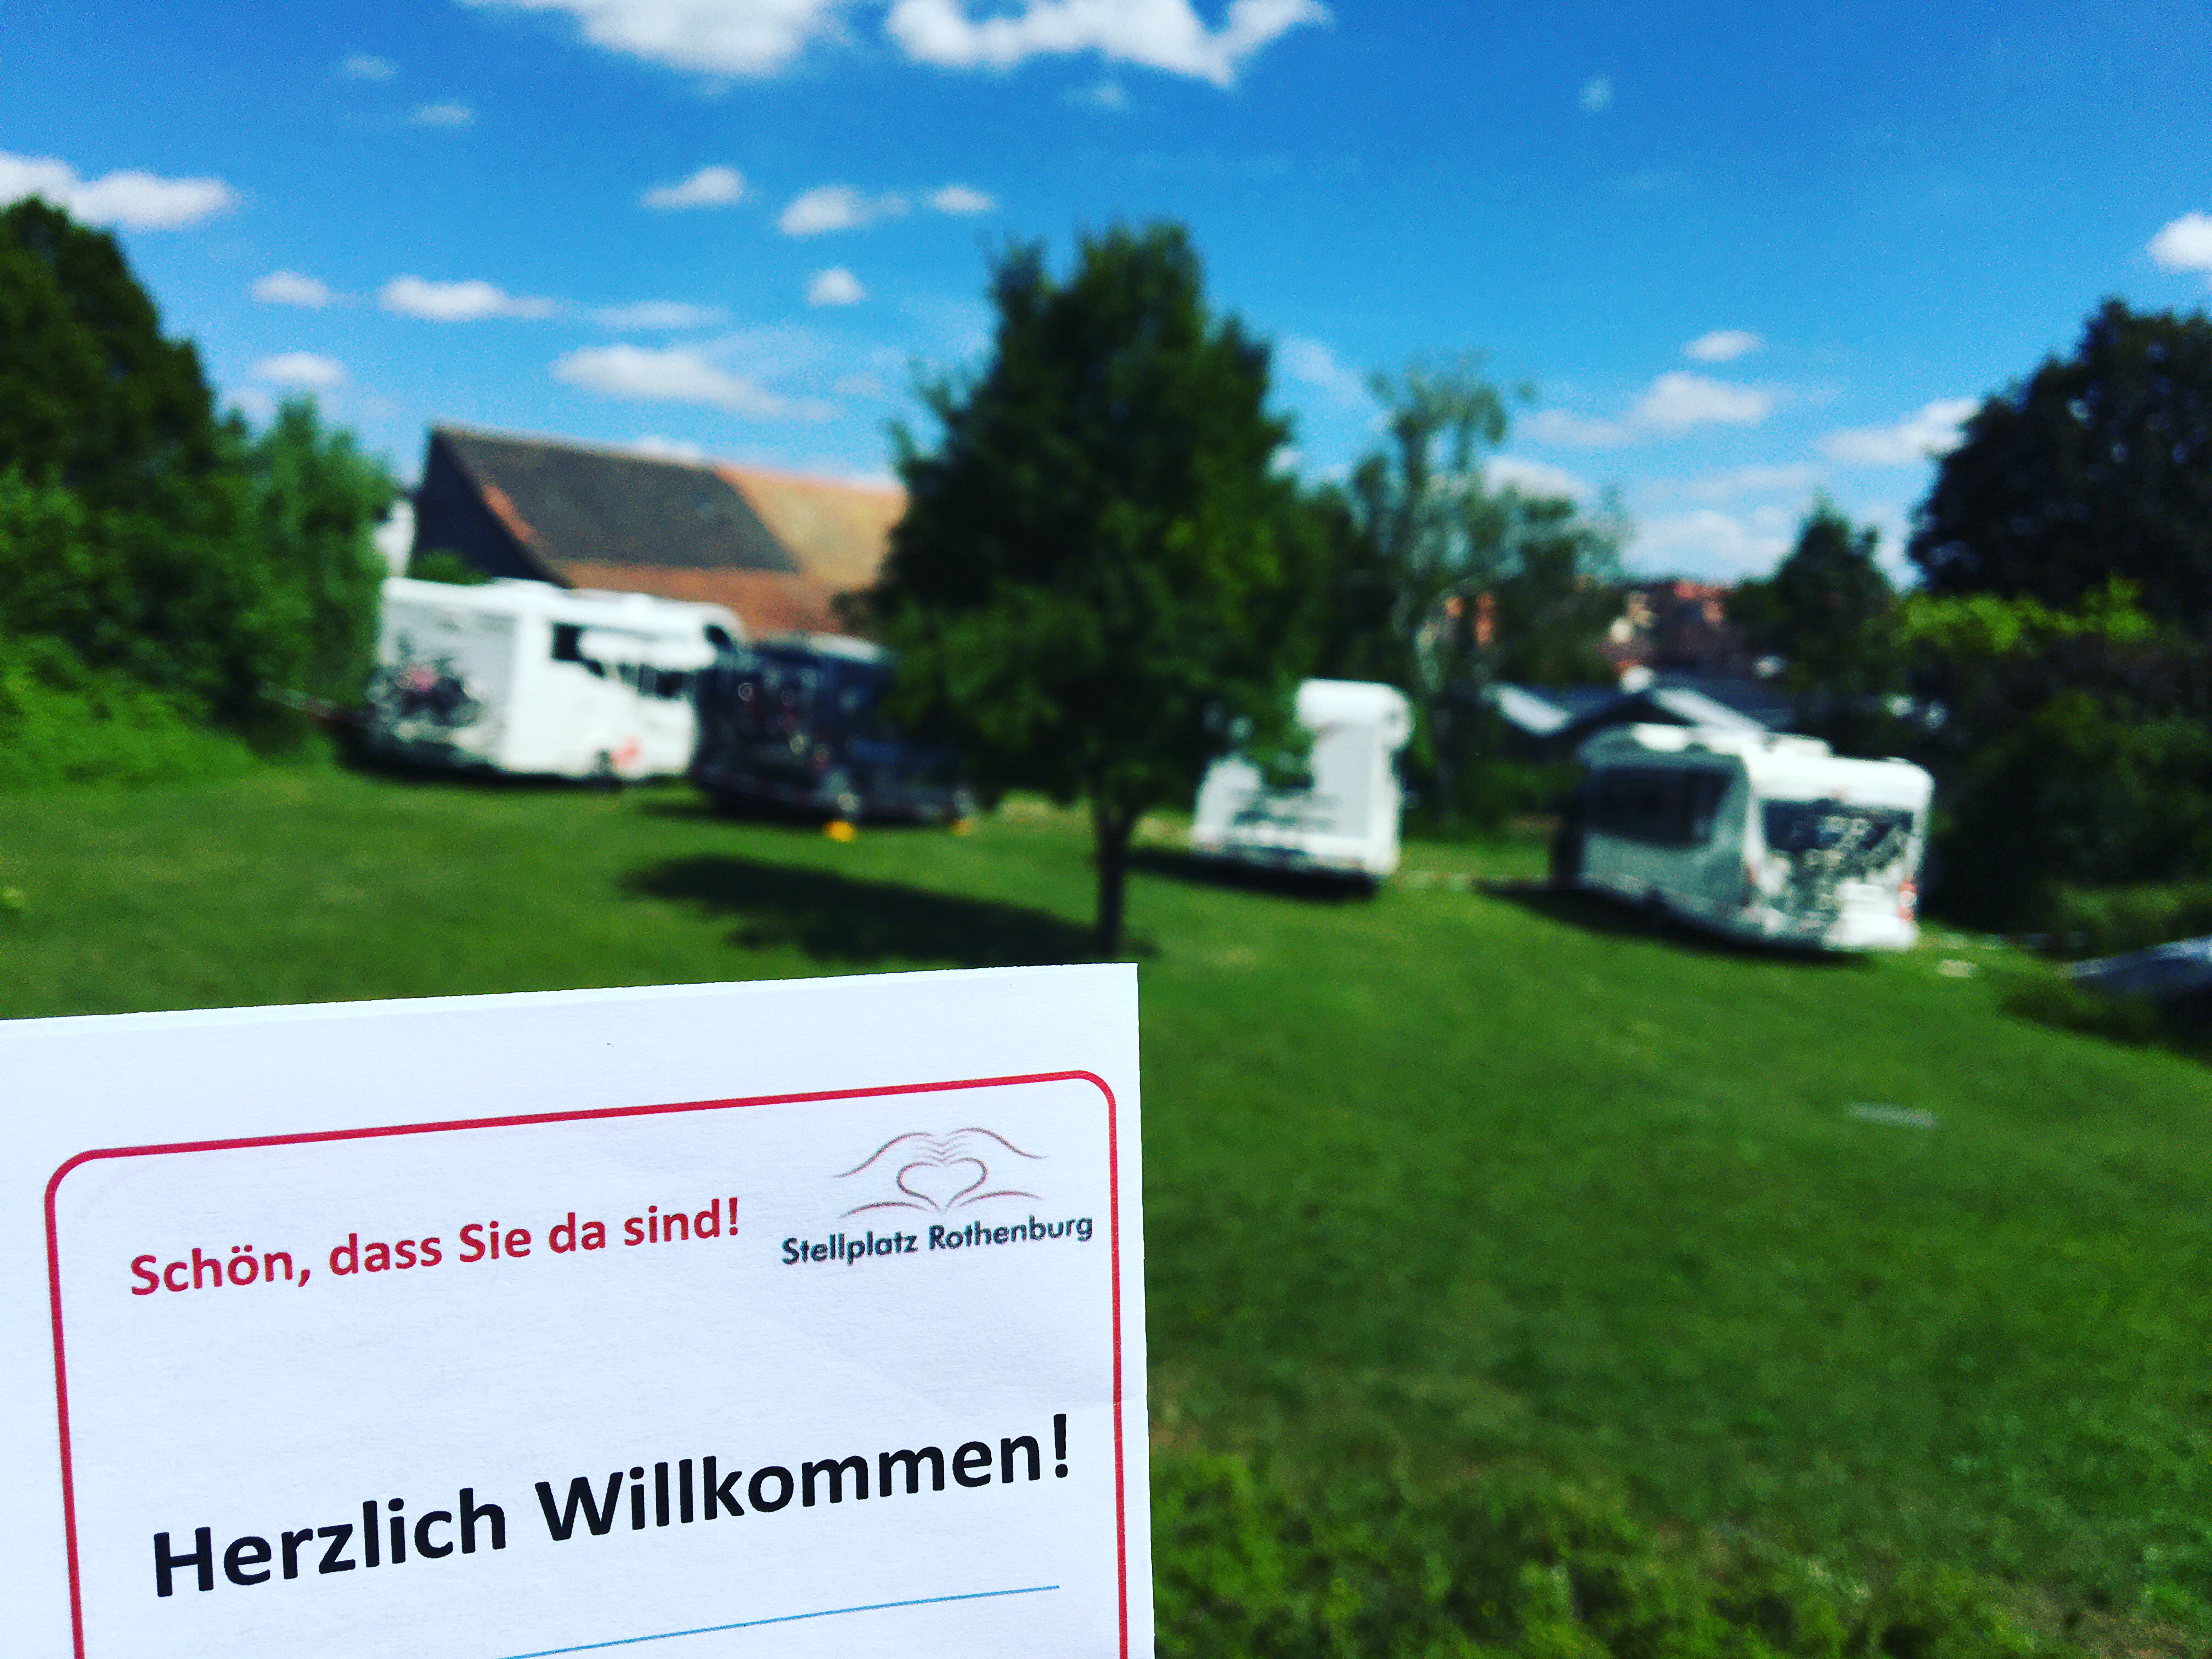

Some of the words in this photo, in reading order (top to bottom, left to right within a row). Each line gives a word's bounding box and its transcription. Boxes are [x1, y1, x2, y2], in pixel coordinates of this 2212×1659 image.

[130, 1245, 312, 1296] Schön,
[329, 1233, 443, 1277] dass
[459, 1220, 532, 1263] Sie
[549, 1211, 607, 1254] da
[623, 1196, 740, 1247] sind!
[781, 1230, 919, 1266] Stellplatz
[928, 1214, 1093, 1251] Rothenburg
[153, 1486, 507, 1599] Herzlich
[533, 1412, 1070, 1542] Willkommen!
